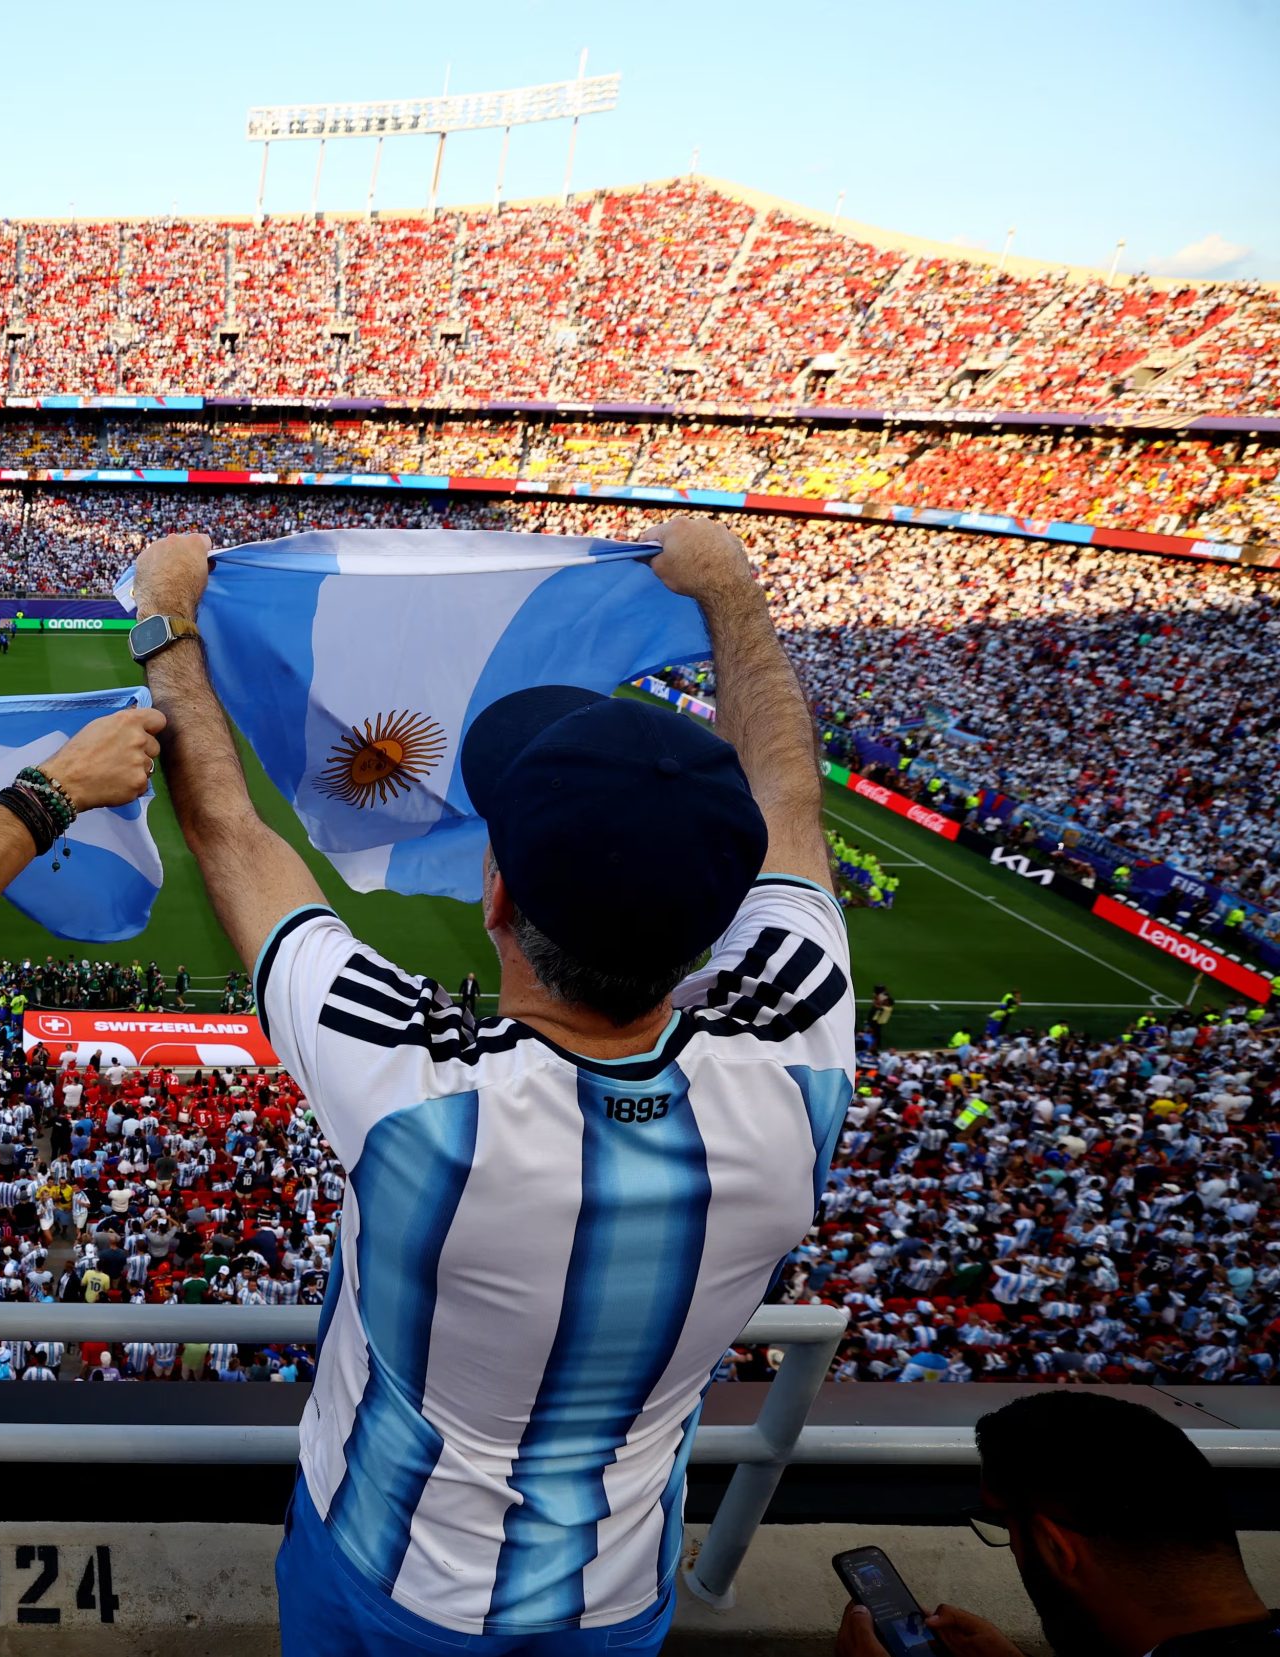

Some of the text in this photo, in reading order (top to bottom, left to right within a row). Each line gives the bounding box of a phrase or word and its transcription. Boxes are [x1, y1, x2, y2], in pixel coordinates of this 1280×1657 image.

[251, 398, 301, 407] KANSAS
[955, 412, 998, 423] CITY
[48, 618, 104, 630] aramco
[649, 680, 670, 701] VISA
[990, 846, 1056, 886] KIA
[1170, 874, 1207, 900] FIFA
[1137, 919, 1218, 973] Lenovo
[93, 1020, 249, 1035] SWITZERLAND
[603, 1093, 672, 1123] 1893
[24, 1154, 36, 1164] 10
[242, 1175, 253, 1186] 10
[90, 1280, 101, 1292] 10
